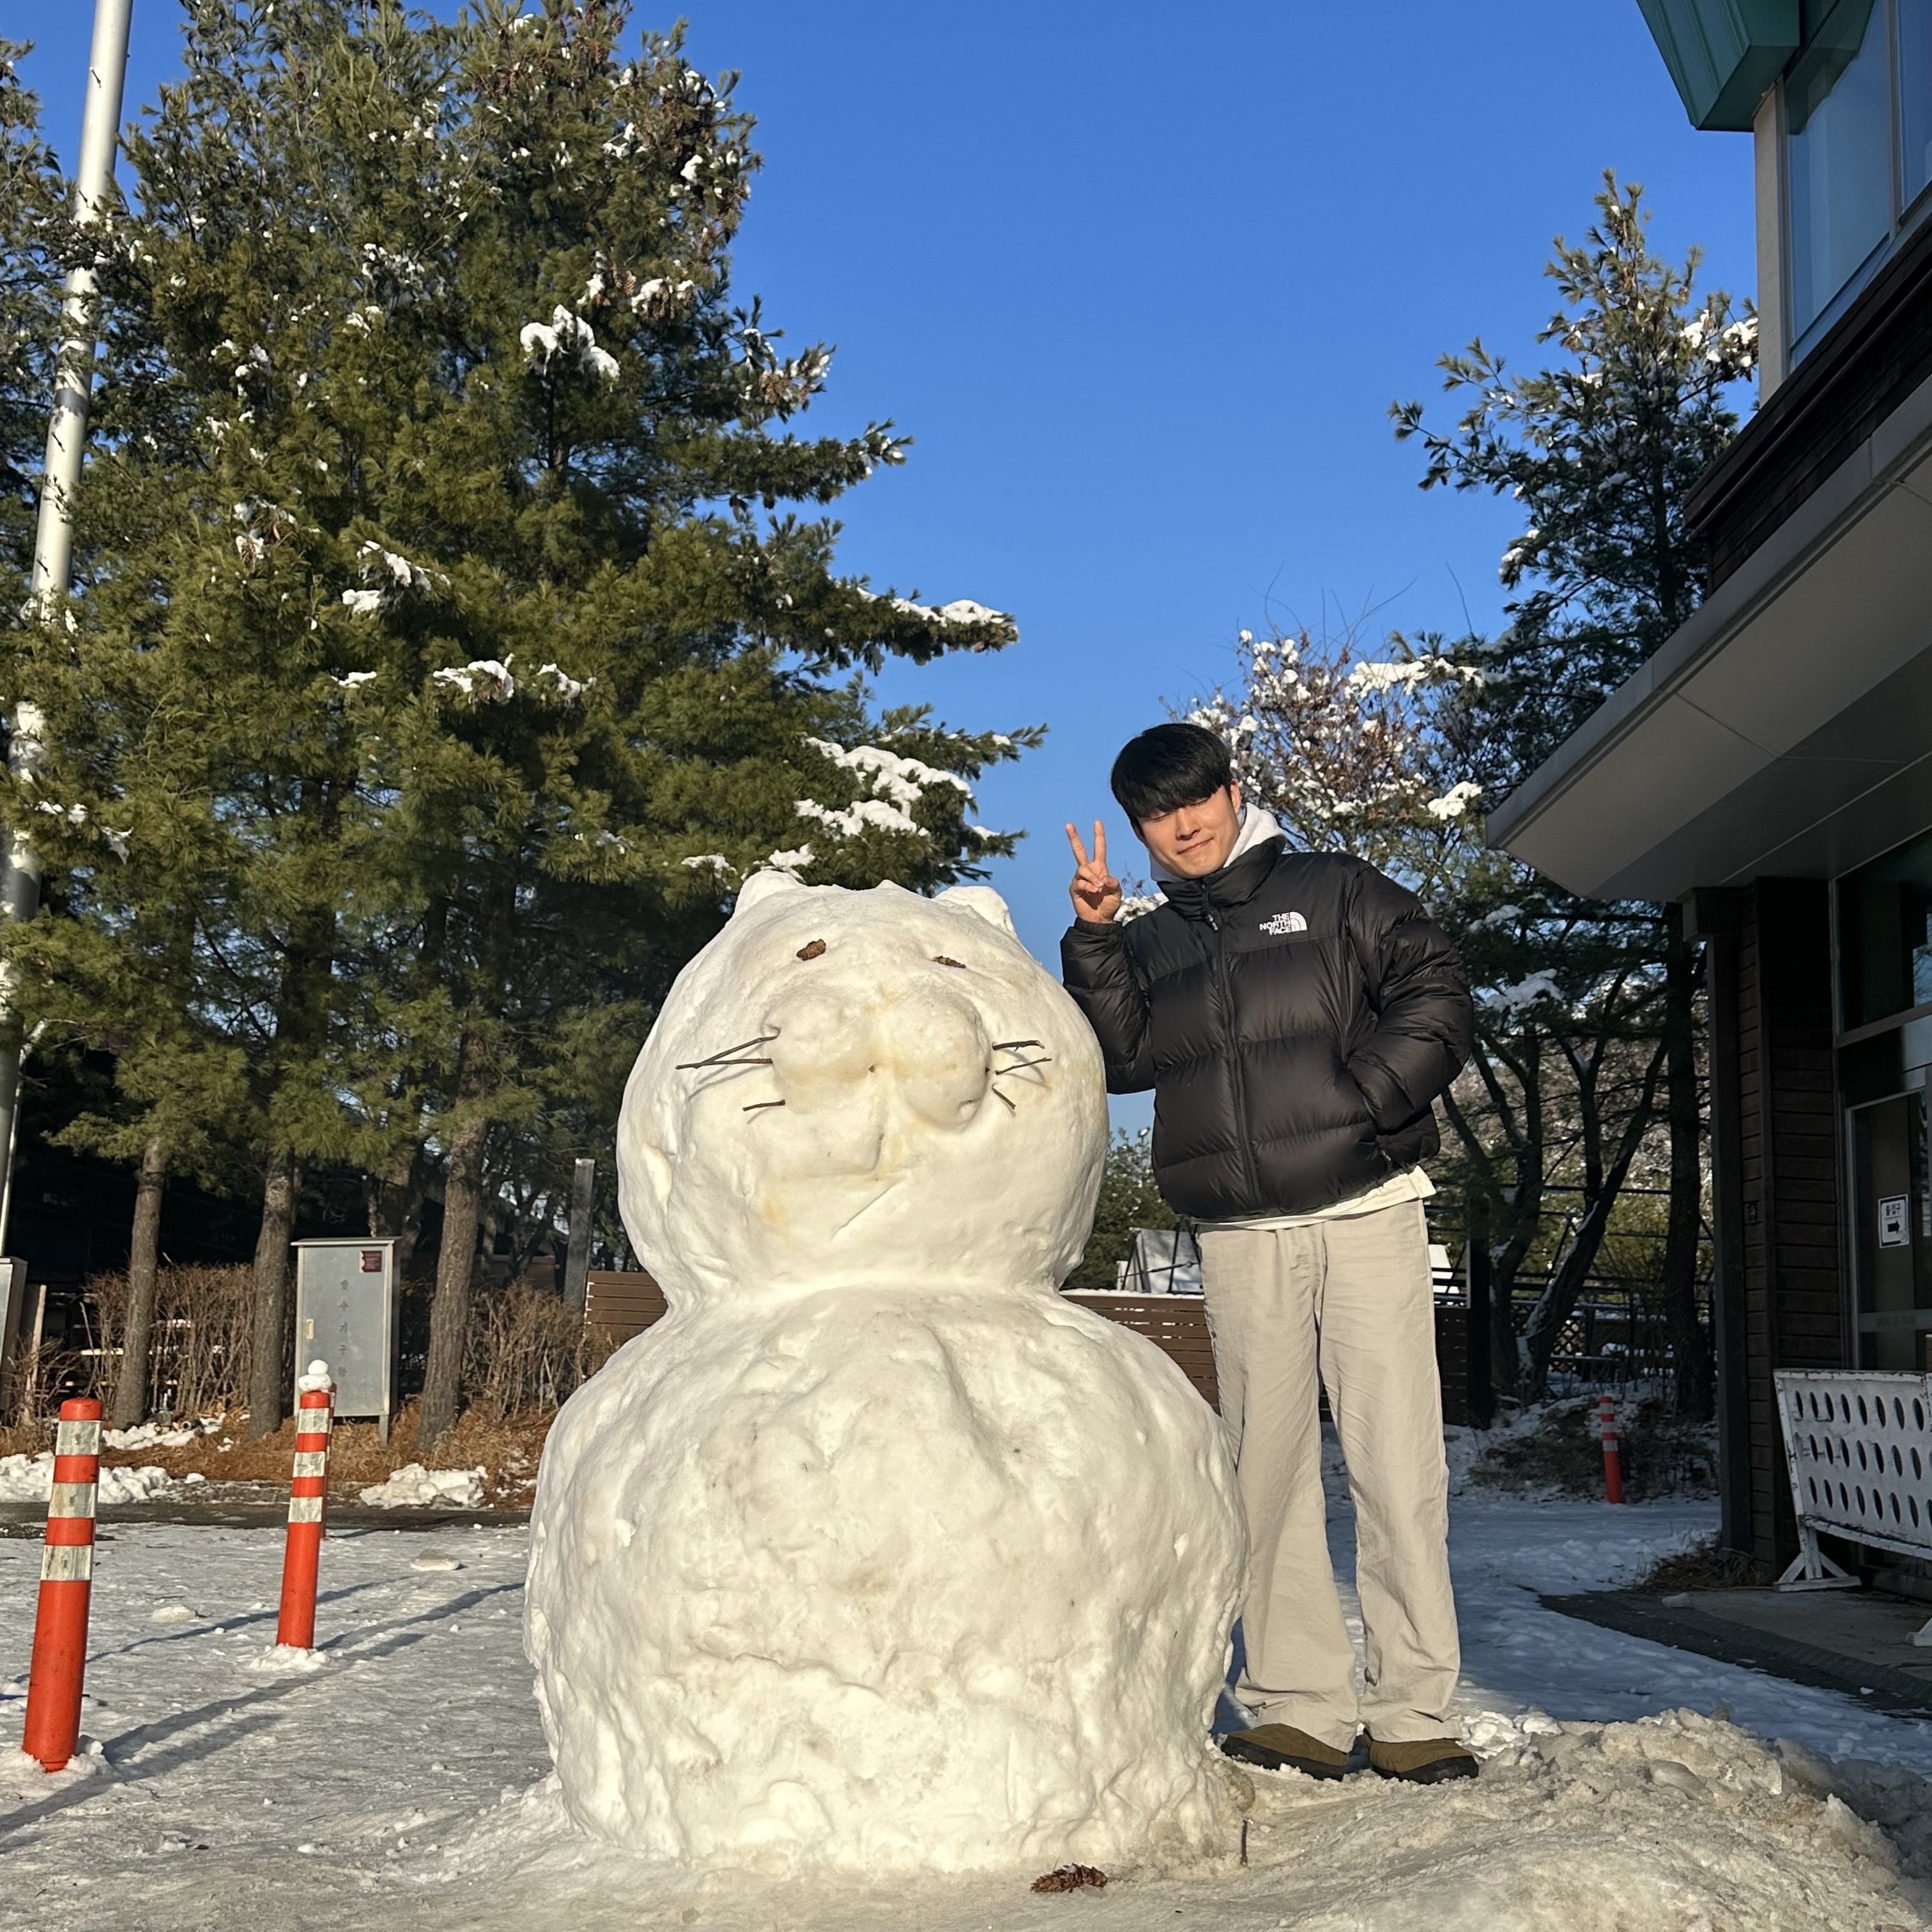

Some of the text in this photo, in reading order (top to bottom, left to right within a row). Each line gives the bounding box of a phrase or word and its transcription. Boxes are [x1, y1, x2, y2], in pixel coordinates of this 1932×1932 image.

[1271, 912, 1290, 921] THE
[1259, 920, 1290, 931] NORTH
[1269, 926, 1291, 936] FACE
